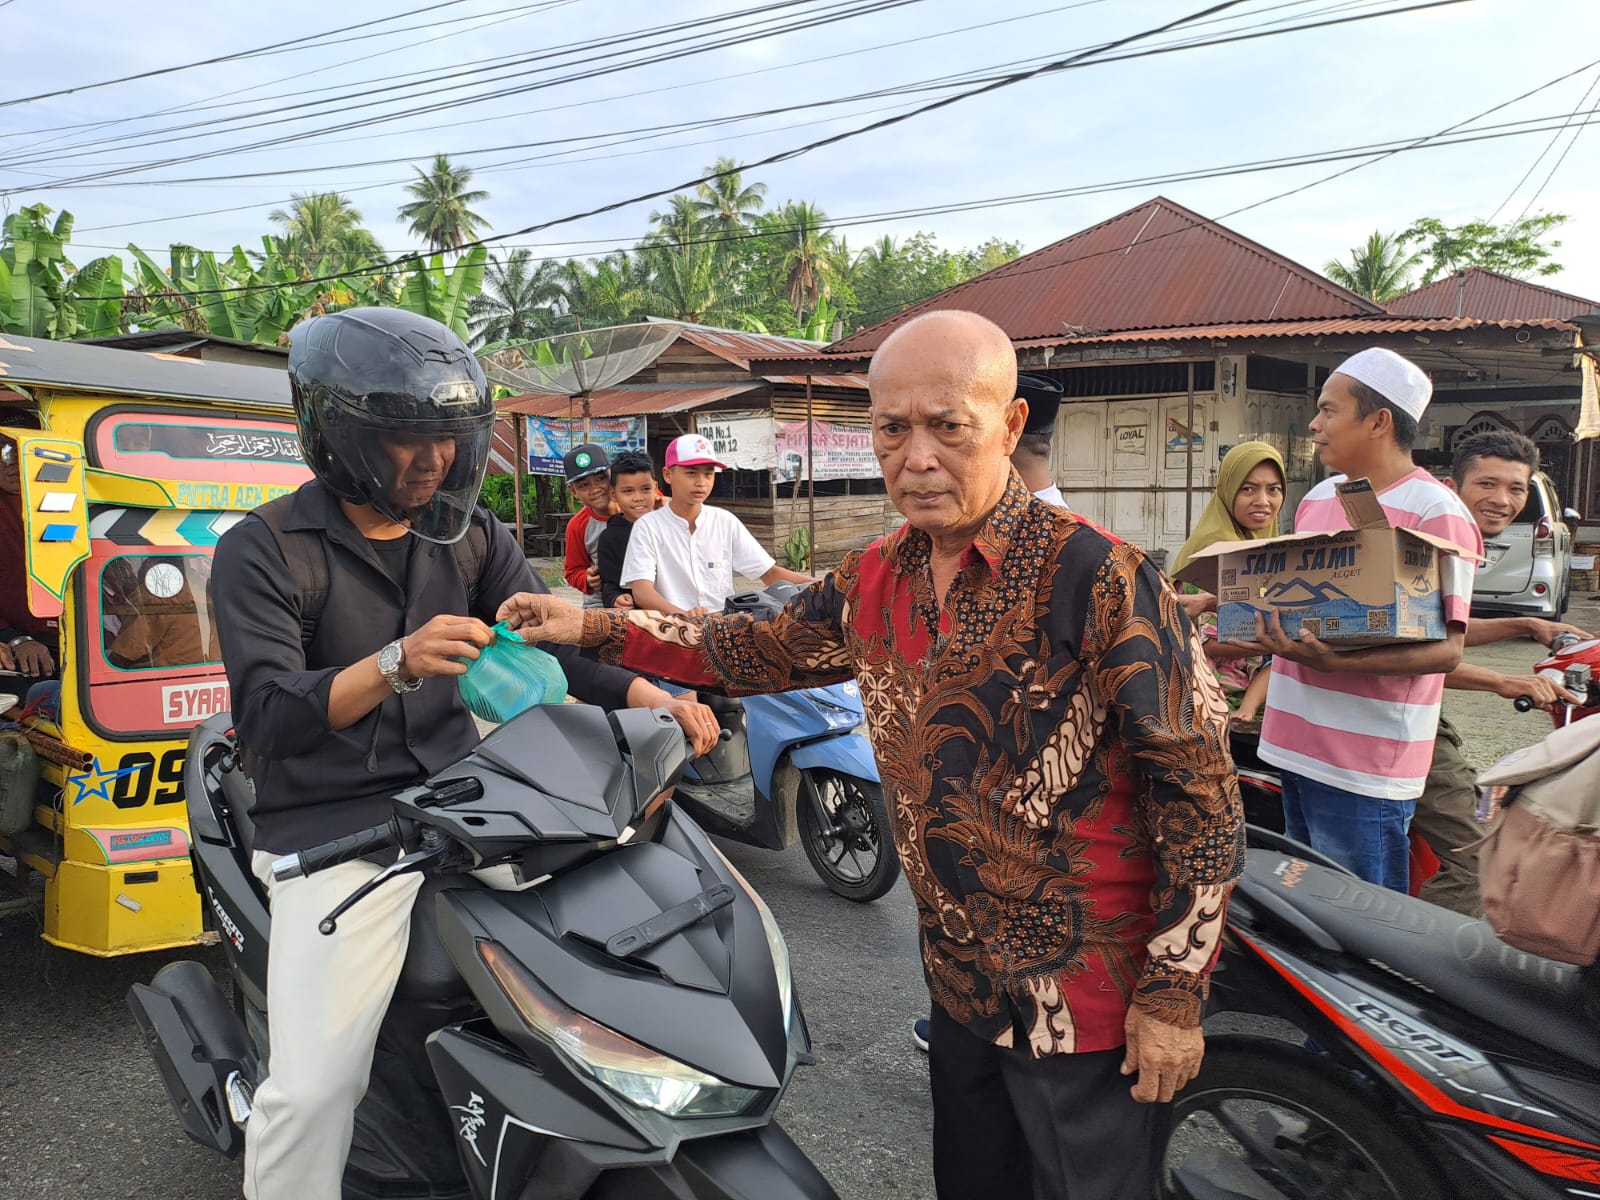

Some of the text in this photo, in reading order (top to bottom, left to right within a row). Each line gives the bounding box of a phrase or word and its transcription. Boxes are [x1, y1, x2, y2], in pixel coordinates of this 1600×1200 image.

[786, 433, 870, 449] MITRA SEJATI
[1120, 429, 1144, 440] LOYAL
[728, 439, 737, 452] 12
[177, 483, 231, 508] PUTRA
[1241, 552, 1287, 575] SAM
[1326, 618, 1340, 629] SNI
[112, 748, 186, 809] 09
